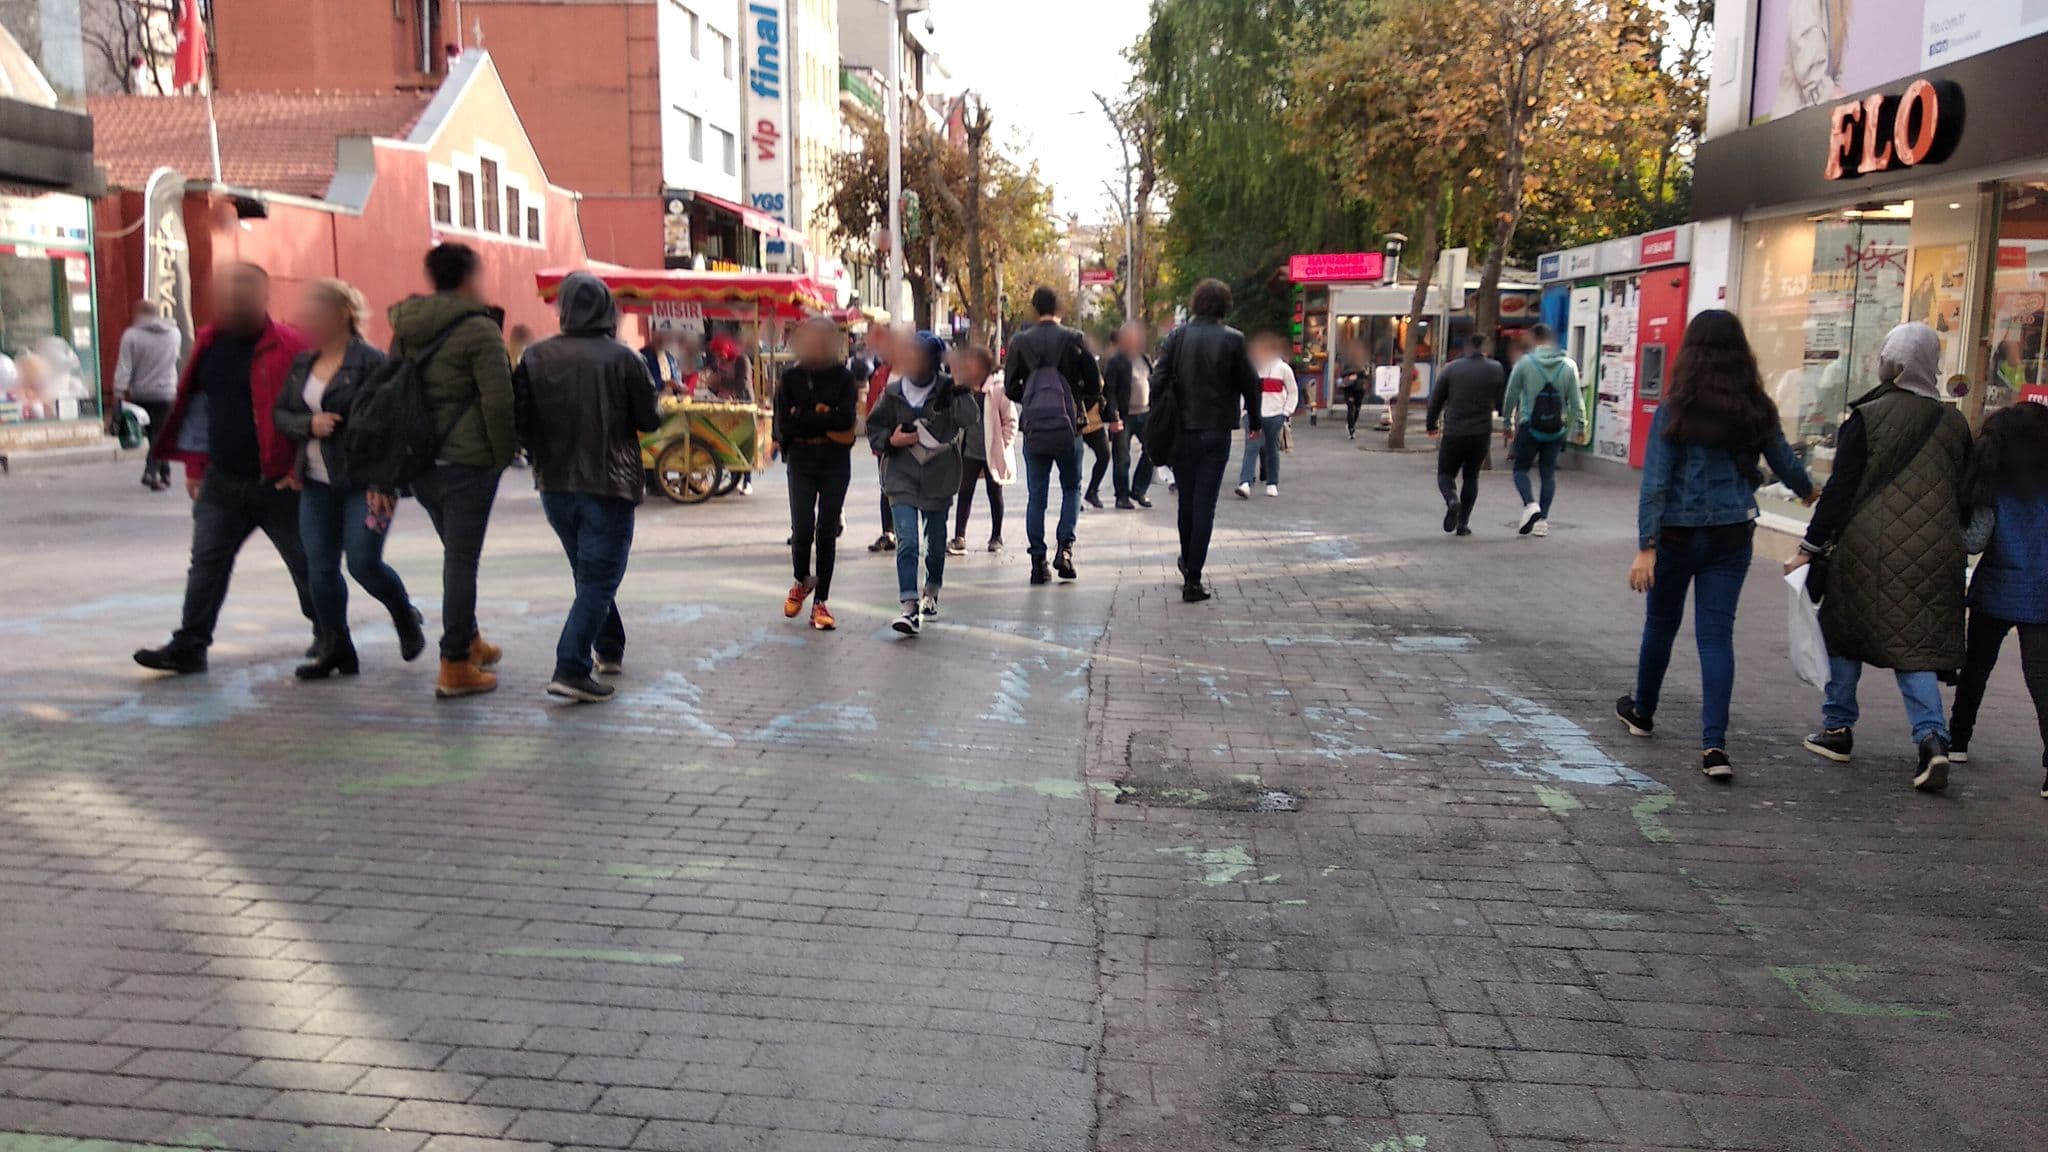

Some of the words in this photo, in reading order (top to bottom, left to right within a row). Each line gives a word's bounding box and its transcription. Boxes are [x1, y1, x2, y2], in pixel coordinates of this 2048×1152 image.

[749, 4, 780, 99] final
[1824, 79, 1940, 181] FLO
[752, 193, 784, 211] YGS
[655, 303, 699, 318] MISIR
